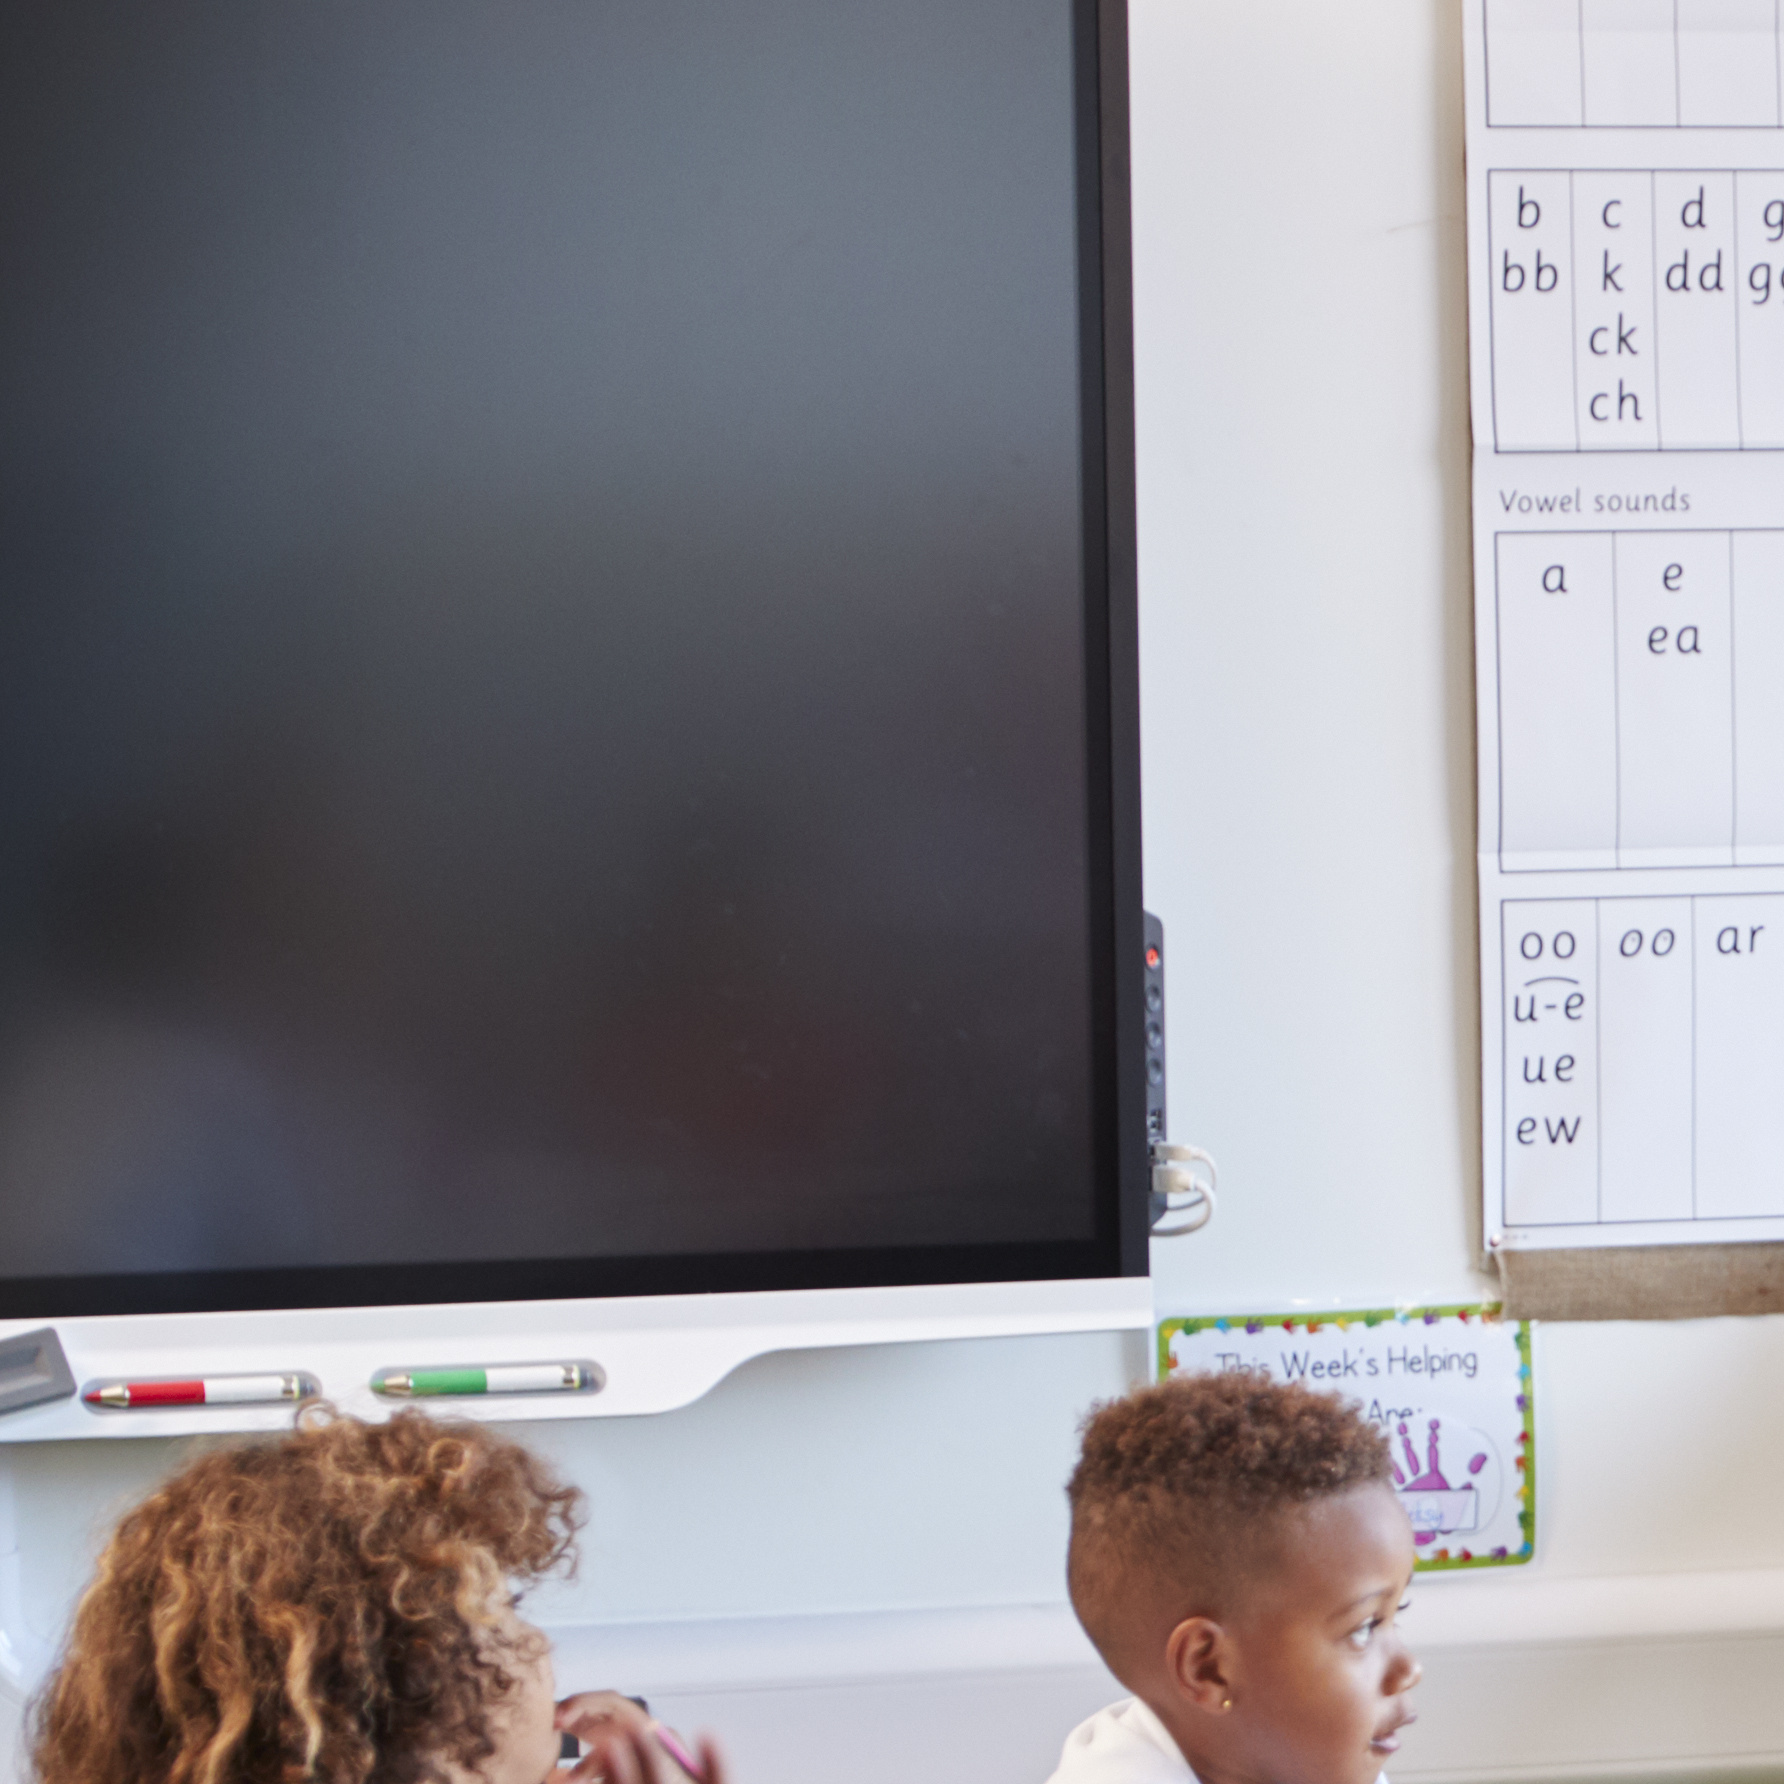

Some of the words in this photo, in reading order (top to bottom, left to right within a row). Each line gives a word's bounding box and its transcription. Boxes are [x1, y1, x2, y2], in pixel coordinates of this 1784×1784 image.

[1517, 185, 1541, 229] b
[1601, 199, 1622, 230] c
[1680, 186, 1707, 229] d
[1502, 249, 1559, 293] bb
[1602, 249, 1623, 293] k
[1665, 249, 1724, 292] dd
[1588, 312, 1638, 356] ck
[1589, 379, 1642, 422] ch
[1499, 489, 1581, 513] Vowel
[1594, 486, 1691, 513] sounds
[1541, 564, 1568, 594] a
[1662, 563, 1684, 592] e
[1647, 625, 1702, 655] ea
[1519, 930, 1577, 961] oo
[1618, 928, 1676, 959] oo
[1716, 925, 1764, 955] ar
[1523, 1054, 1576, 1084] ue
[1516, 1116, 1581, 1146] ew
[1282, 1347, 1380, 1379] Week's
[1387, 1346, 1478, 1379] Helping
